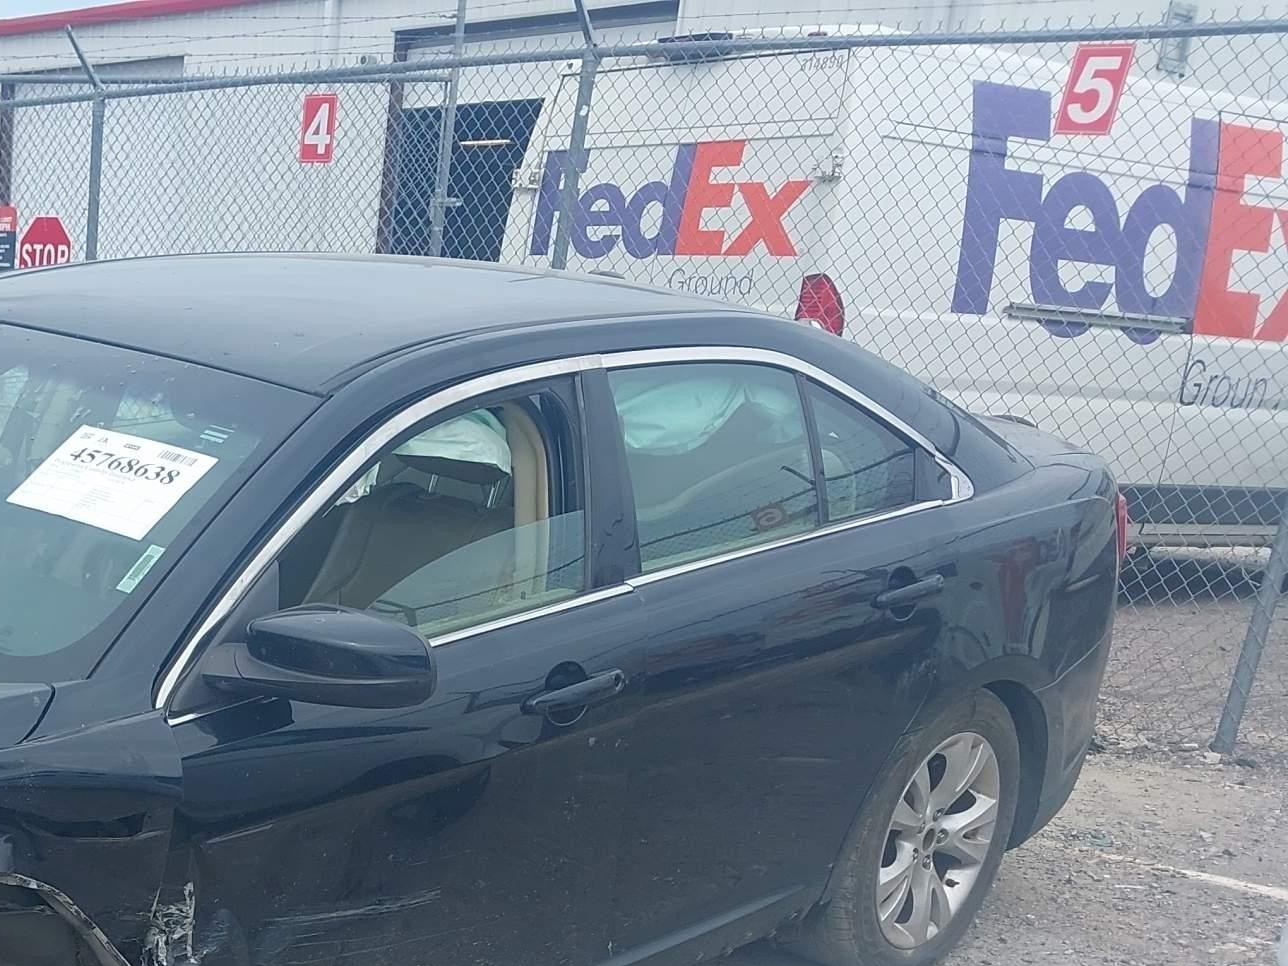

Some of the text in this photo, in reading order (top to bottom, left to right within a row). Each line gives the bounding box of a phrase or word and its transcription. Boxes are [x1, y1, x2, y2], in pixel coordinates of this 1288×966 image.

[1067, 56, 1123, 124] 5
[304, 103, 331, 155] 4
[529, 139, 813, 259] FedEx
[22, 243, 69, 268] STOP
[668, 269, 754, 297] Ground
[1179, 359, 1278, 410] Groun
[70, 447, 181, 485] 45768638
